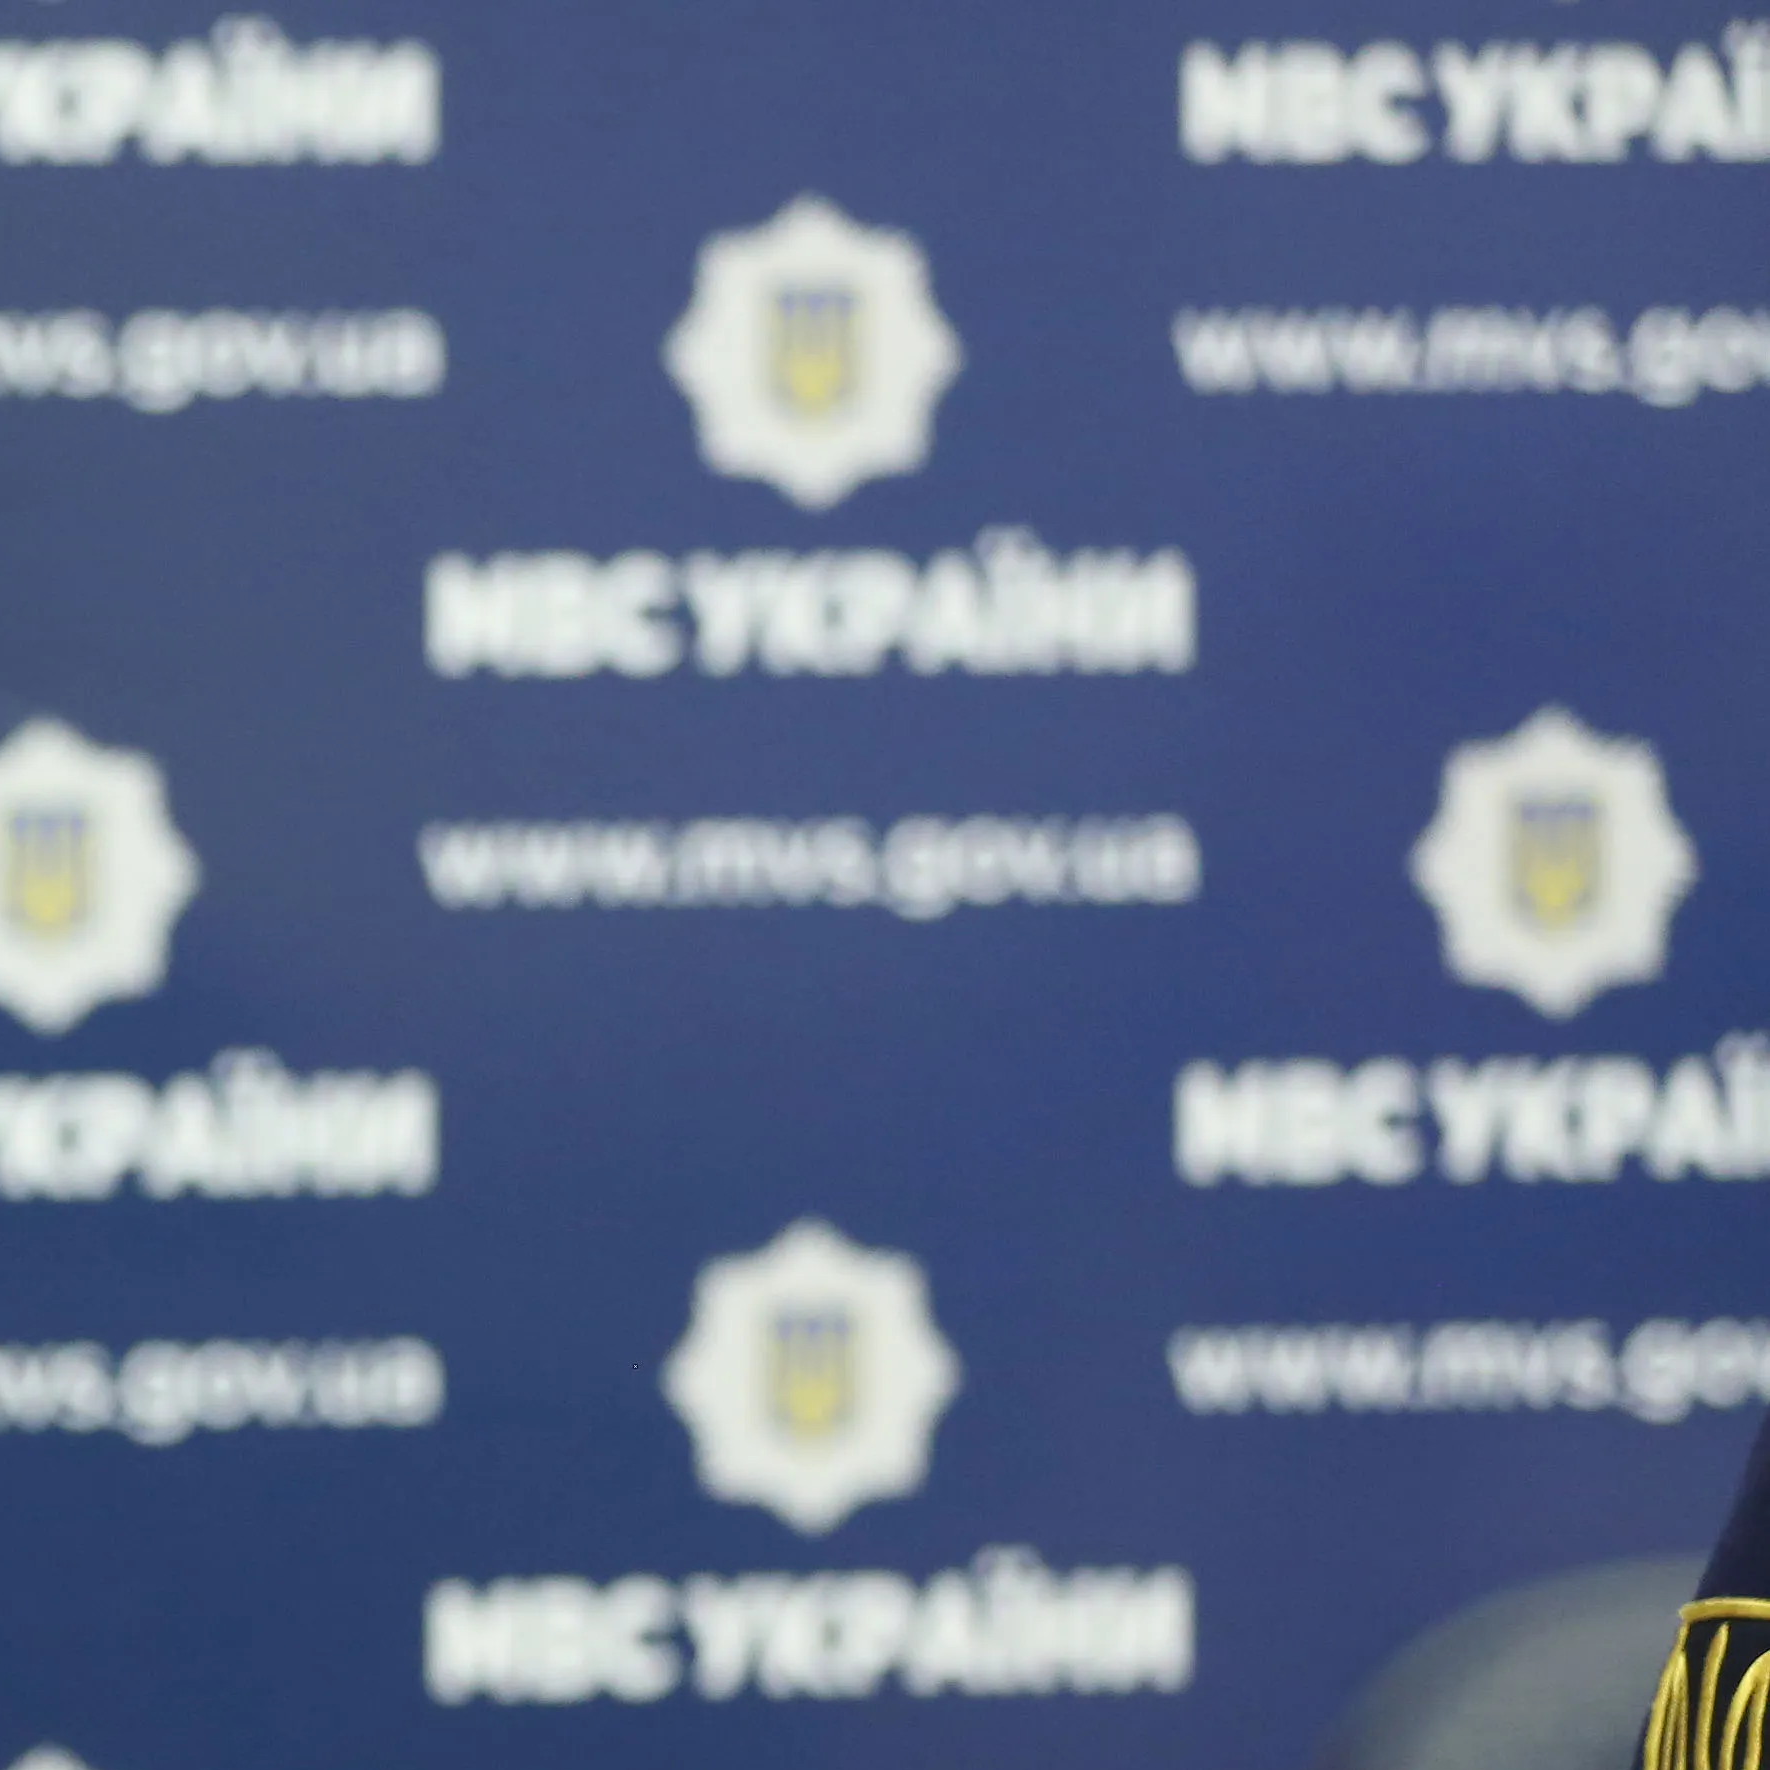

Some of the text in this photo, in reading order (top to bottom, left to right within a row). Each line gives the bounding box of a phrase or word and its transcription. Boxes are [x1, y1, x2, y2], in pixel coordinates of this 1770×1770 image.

[1180, 23, 1770, 164] МВС УКРАЇ
[1173, 308, 1770, 407] www.mvs.go
[425, 529, 1195, 677] МВС УКРАЇНИ
[419, 815, 1200, 920] www.mvs.gov.ua
[1175, 1036, 1770, 1184] МВС УКРАЇ
[1169, 1321, 1770, 1423] www.mvs.go
[425, 1548, 1194, 1702] МВС УКРАЇНИ
